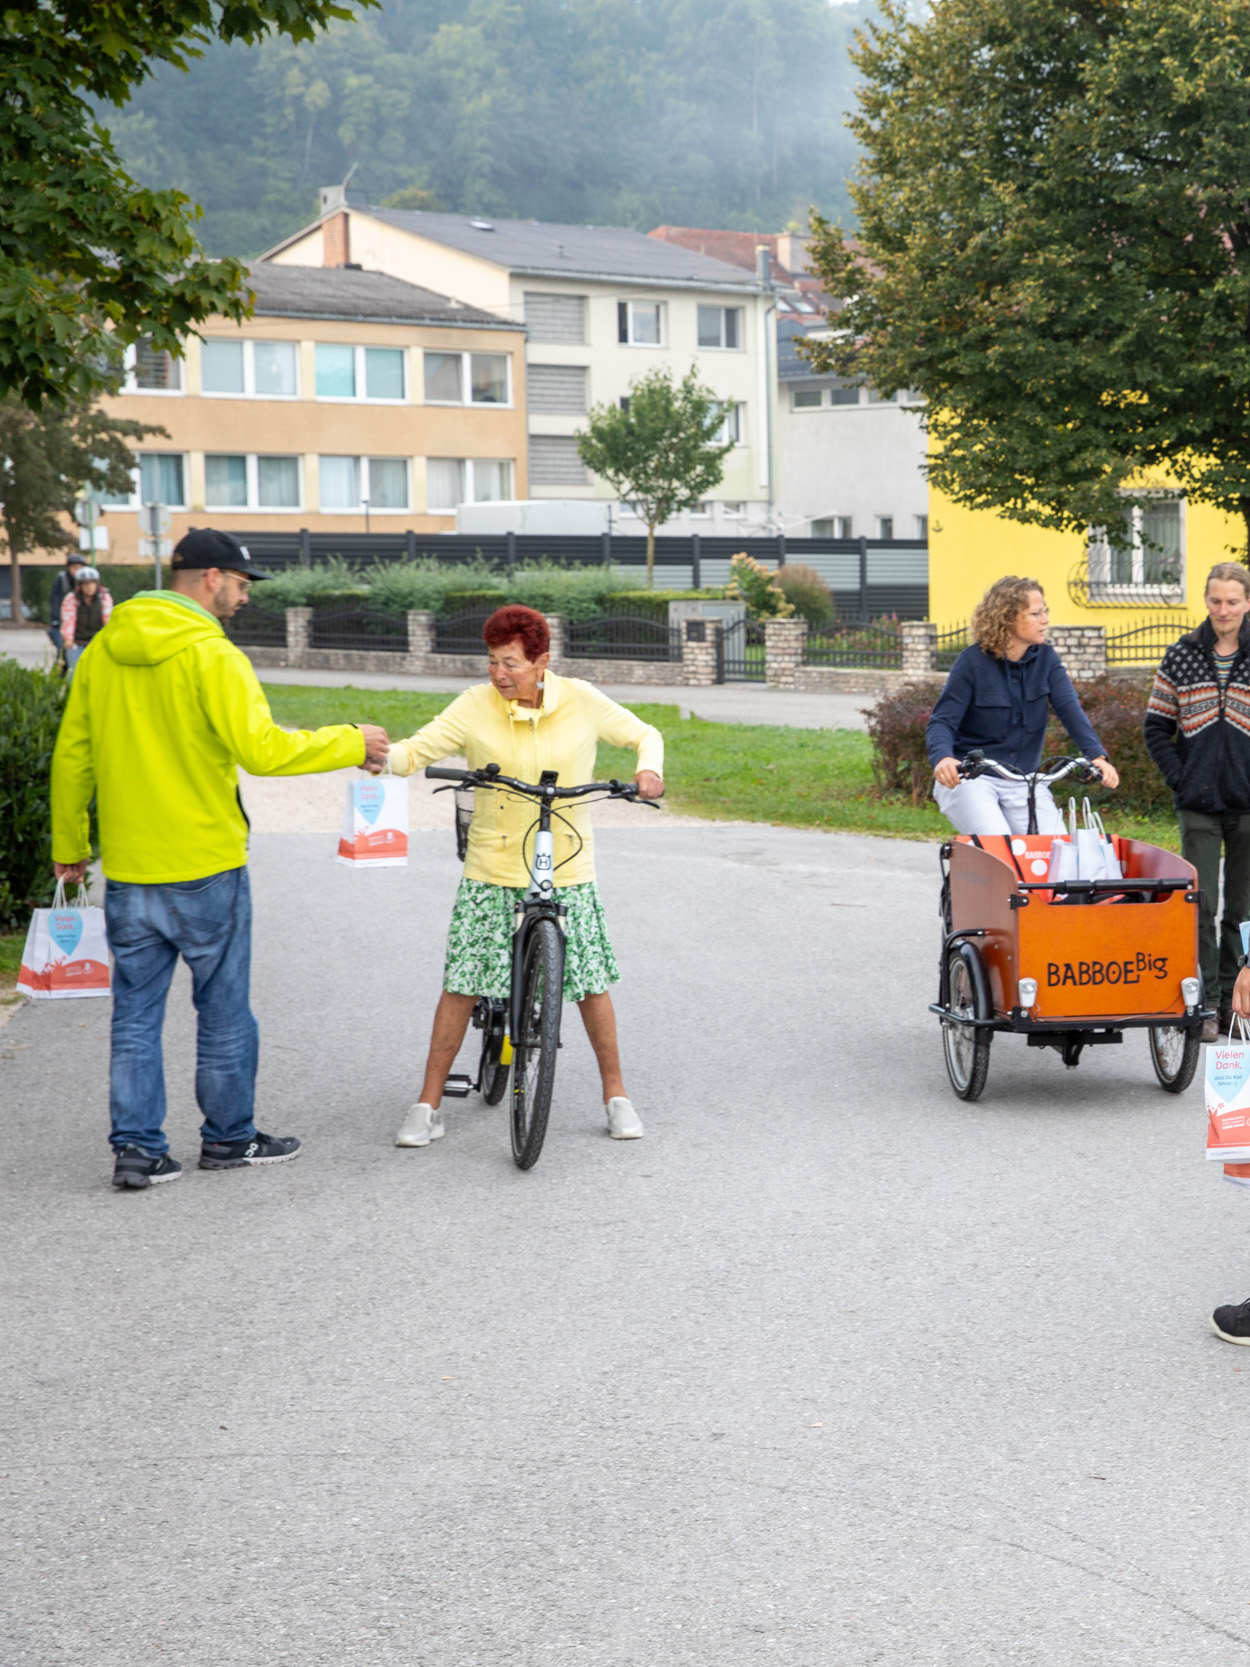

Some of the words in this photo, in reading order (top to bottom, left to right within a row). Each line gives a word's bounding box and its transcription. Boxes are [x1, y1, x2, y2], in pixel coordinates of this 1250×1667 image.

[1047, 961, 1140, 987] BABBOE
[1136, 952, 1168, 979] Big
[1215, 1050, 1245, 1060] Vielen
[1216, 1060, 1243, 1070] Dank,
